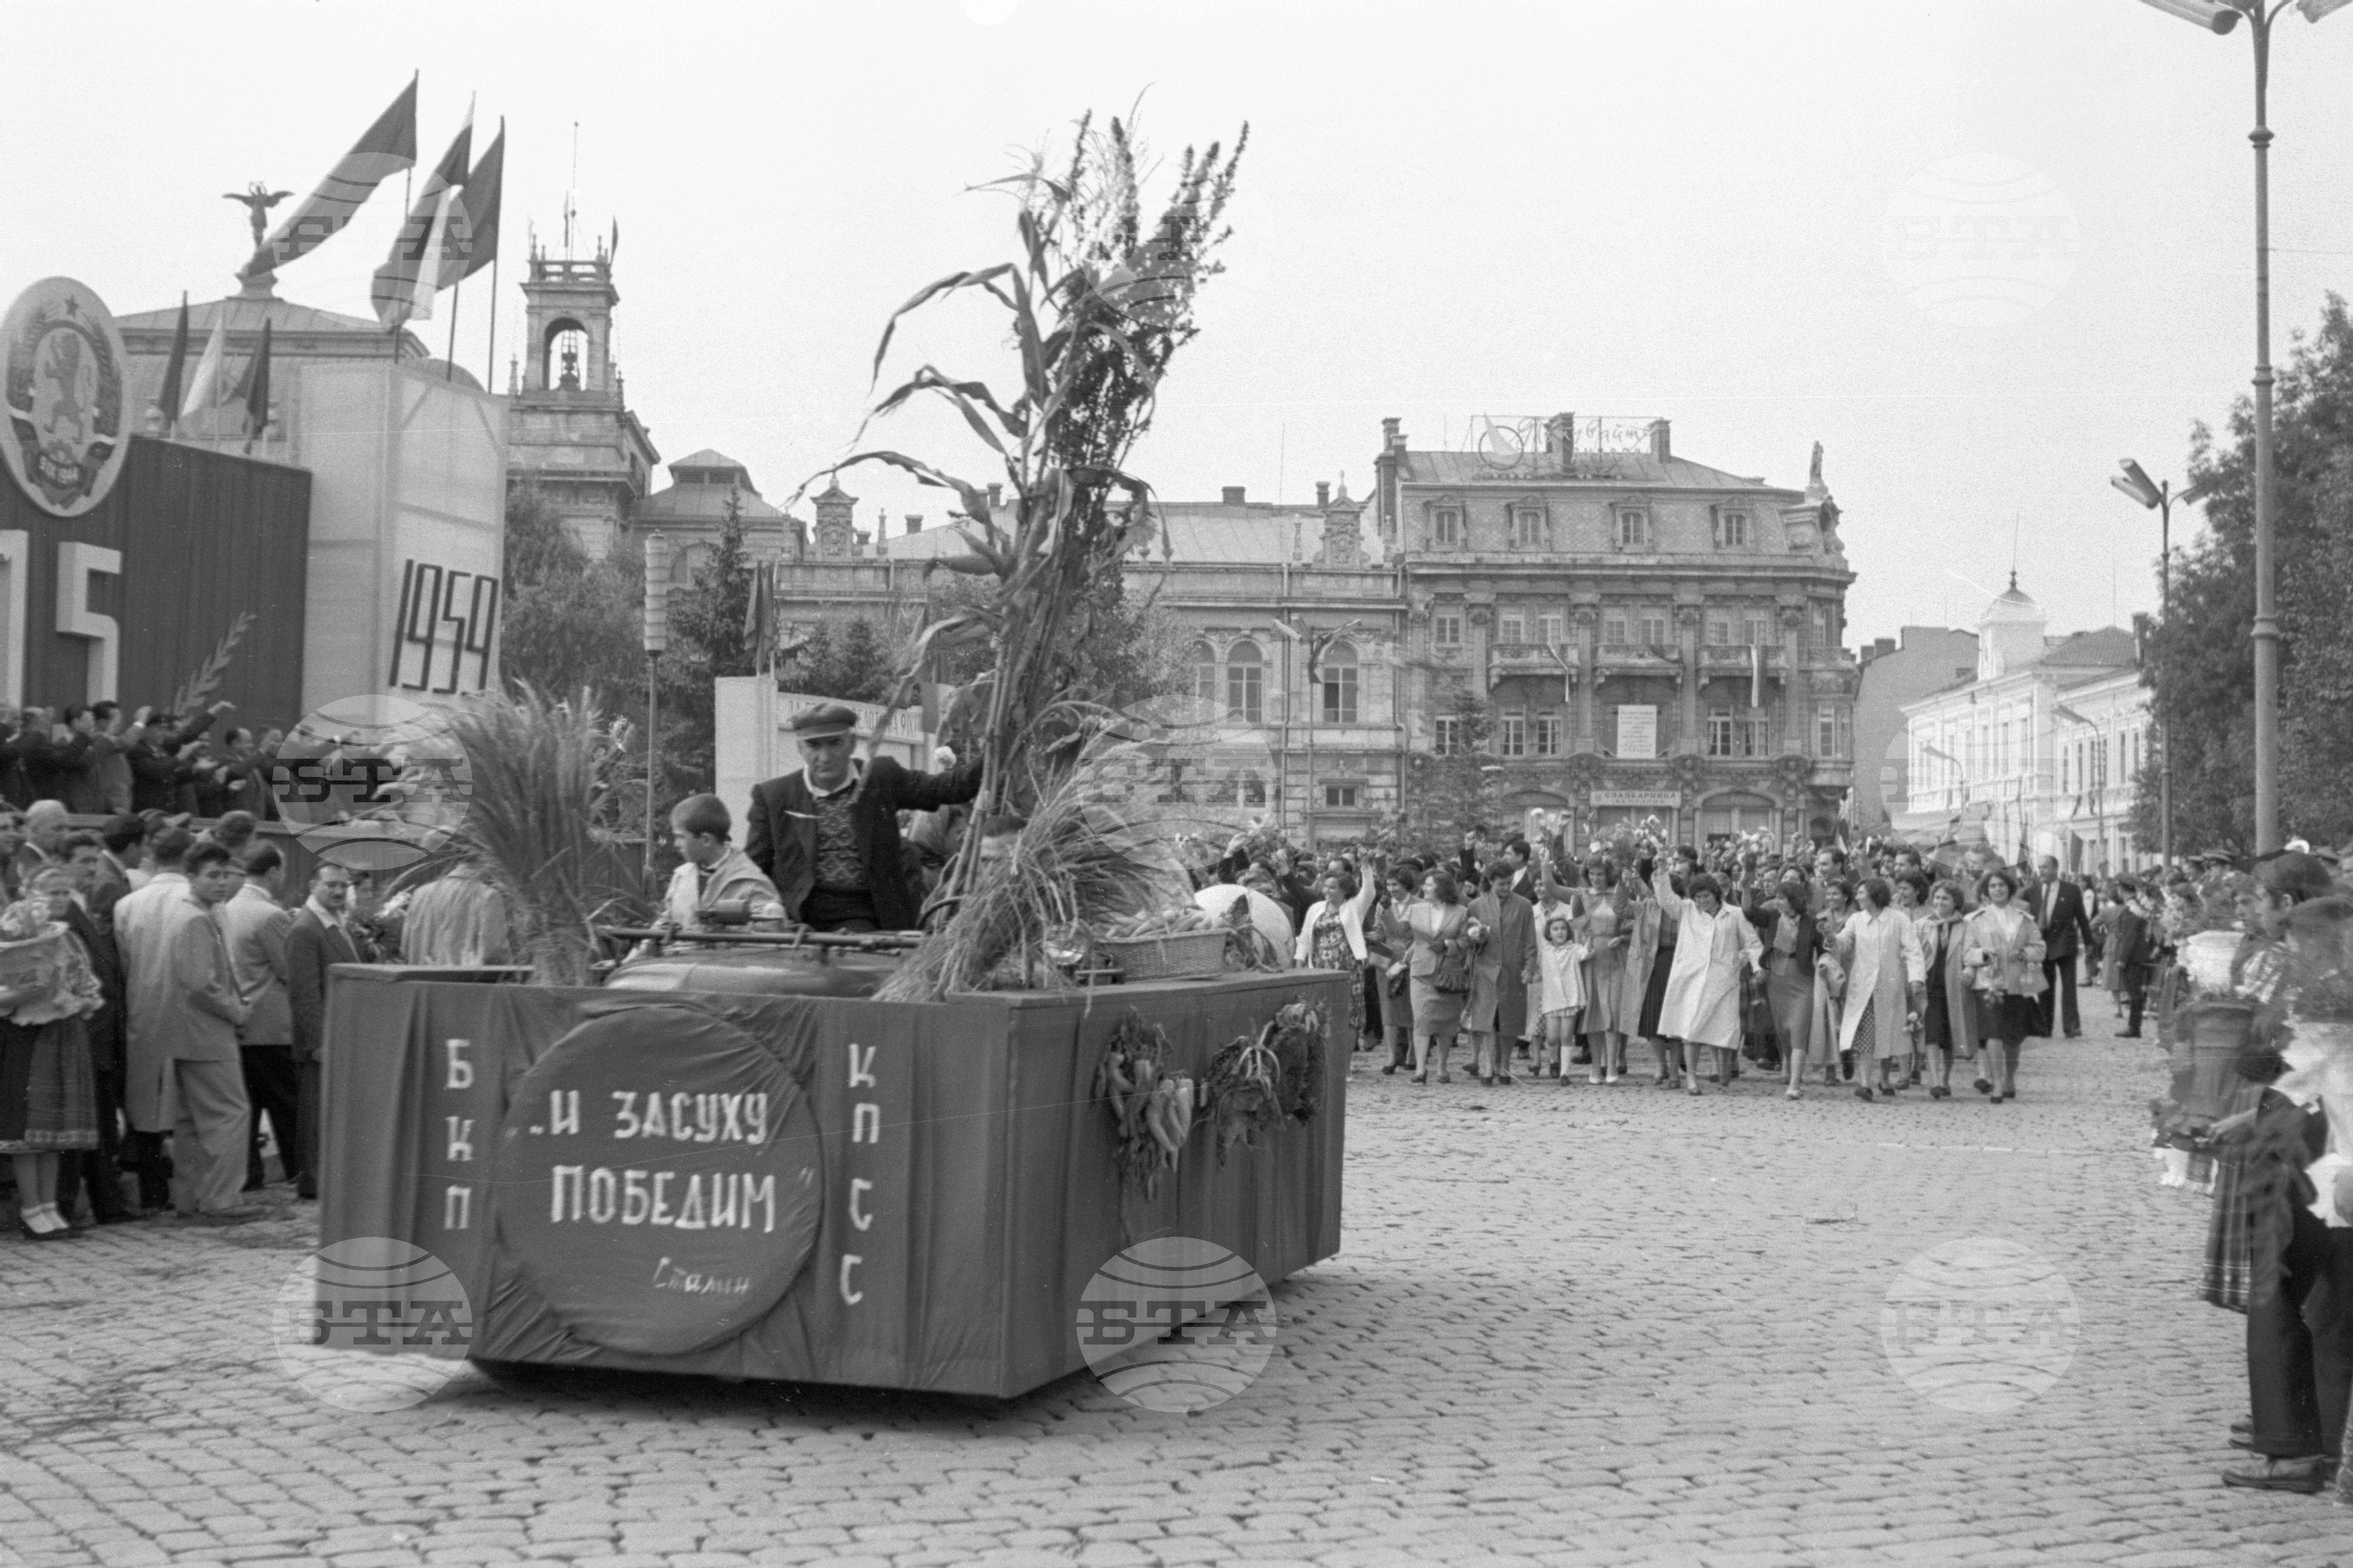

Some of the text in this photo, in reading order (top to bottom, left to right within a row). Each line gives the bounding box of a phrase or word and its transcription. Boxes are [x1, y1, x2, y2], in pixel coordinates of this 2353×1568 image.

[0, 529, 122, 707] 15
[388, 559, 499, 696] 1959
[444, 1038, 474, 1230] БКП
[611, 1091, 768, 1145] ЗАСУХУ
[840, 1043, 881, 1306] КПСС
